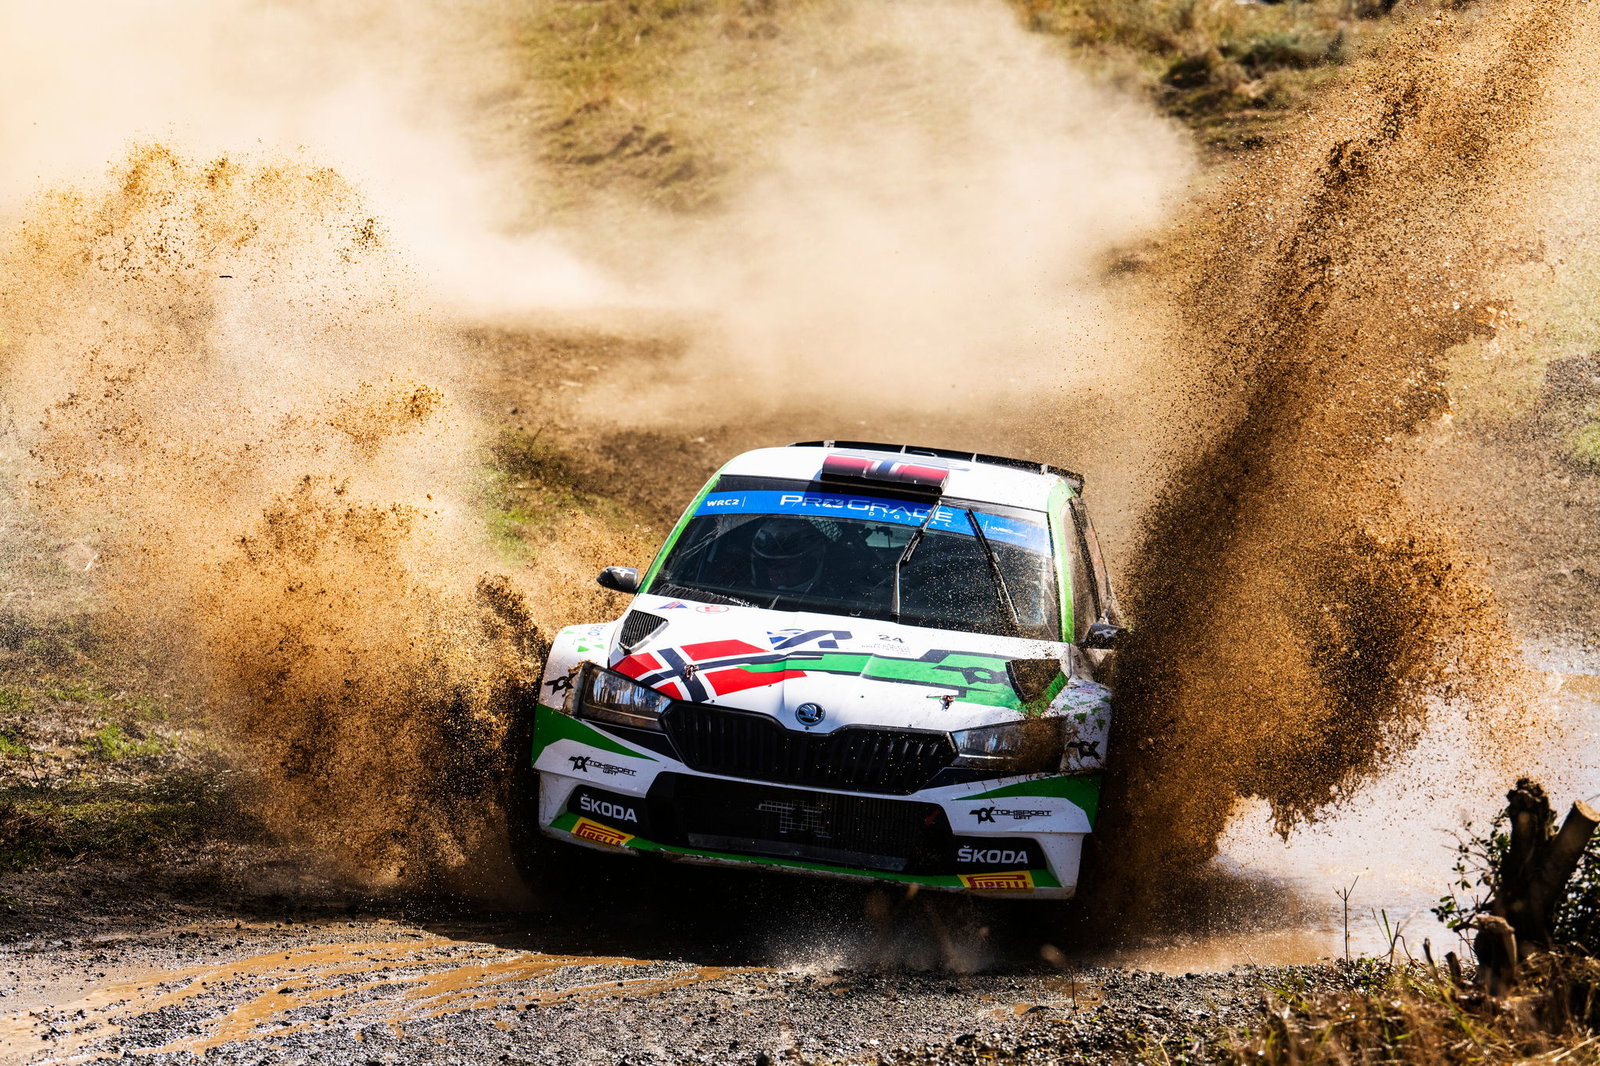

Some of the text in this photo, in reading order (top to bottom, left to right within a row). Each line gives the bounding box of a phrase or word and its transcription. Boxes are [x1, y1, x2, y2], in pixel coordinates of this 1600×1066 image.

[707, 499, 741, 509] WRC2
[869, 511, 950, 527] DIGITAL
[878, 634, 904, 643] 24
[580, 794, 636, 822] ŠKODA
[576, 823, 627, 847] PIRELLI
[957, 845, 1028, 864] ŠKODA
[966, 874, 1027, 889] PIRELLI
